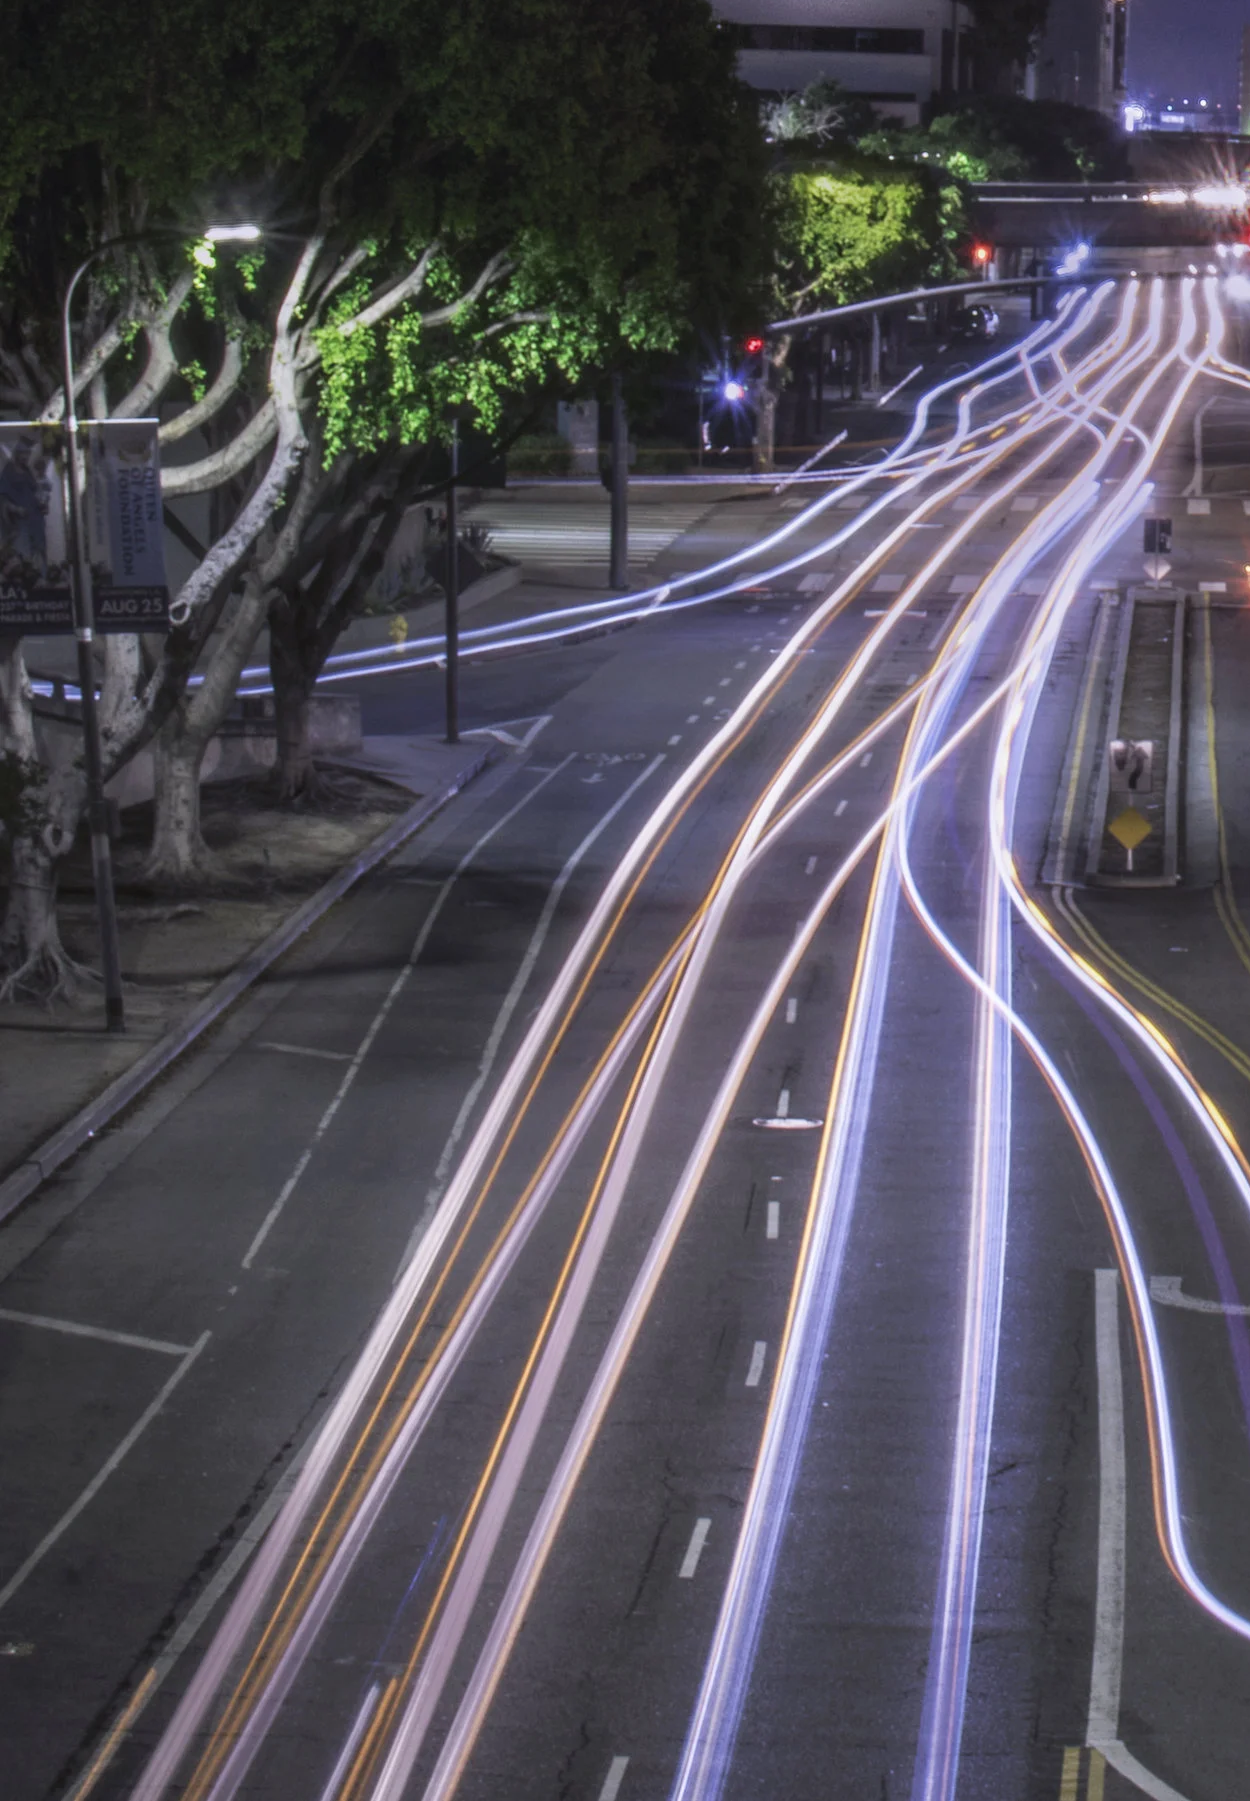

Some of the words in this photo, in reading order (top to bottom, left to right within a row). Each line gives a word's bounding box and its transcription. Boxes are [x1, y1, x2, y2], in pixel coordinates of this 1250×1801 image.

[117, 468, 135, 576] FOUNDATION
[101, 600, 138, 614] AUG
[142, 598, 163, 613] 25
